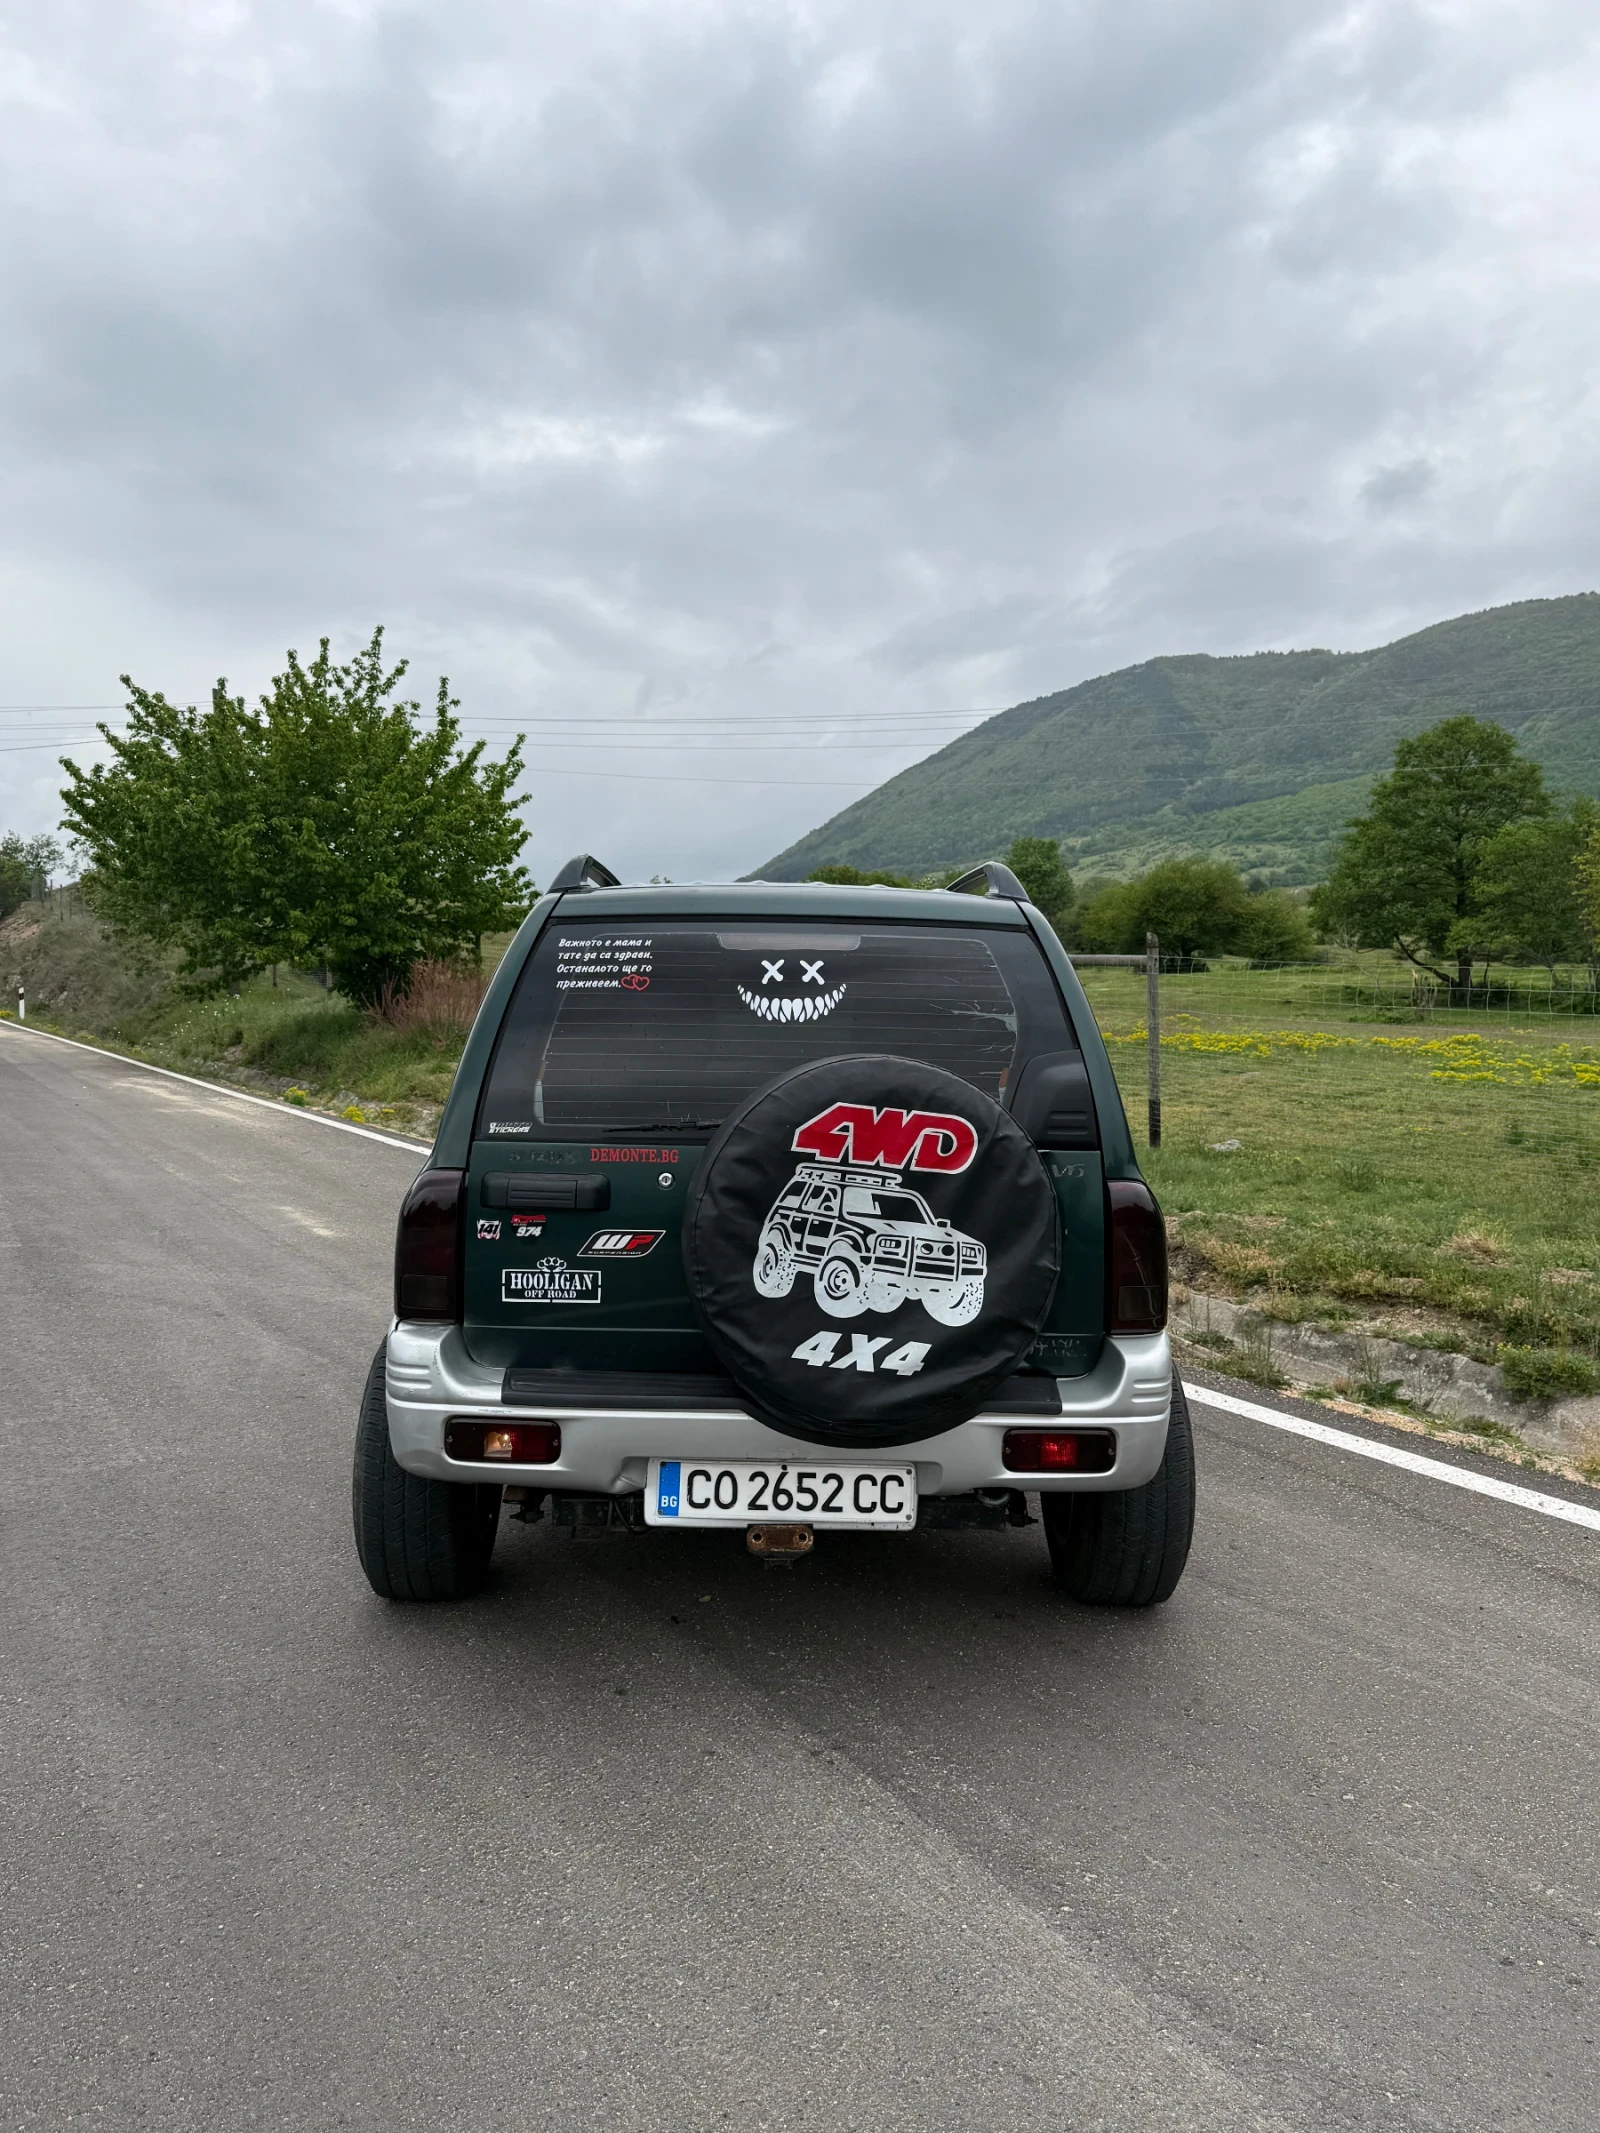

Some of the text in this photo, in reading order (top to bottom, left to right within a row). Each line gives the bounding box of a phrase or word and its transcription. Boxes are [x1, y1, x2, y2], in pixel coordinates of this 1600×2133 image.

[558, 938, 602, 947] Важното
[583, 952, 597, 961] да
[614, 951, 653, 961] здрави.
[556, 964, 619, 973] Останалото
[622, 965, 638, 974] ще
[556, 980, 621, 990] преживеем.
[488, 1126, 531, 1134] STICKERS
[791, 1102, 978, 1174] 4WD
[590, 1148, 679, 1163] DEMONTE.BG
[479, 1224, 499, 1235] 141
[516, 1226, 543, 1237] 974
[592, 1233, 655, 1250] WP
[510, 1272, 593, 1290] HOOLIGAN
[524, 1289, 577, 1299] OFF ROAD
[791, 1331, 932, 1376] 4X4
[661, 1469, 904, 1513] BG CO 2652 CC
